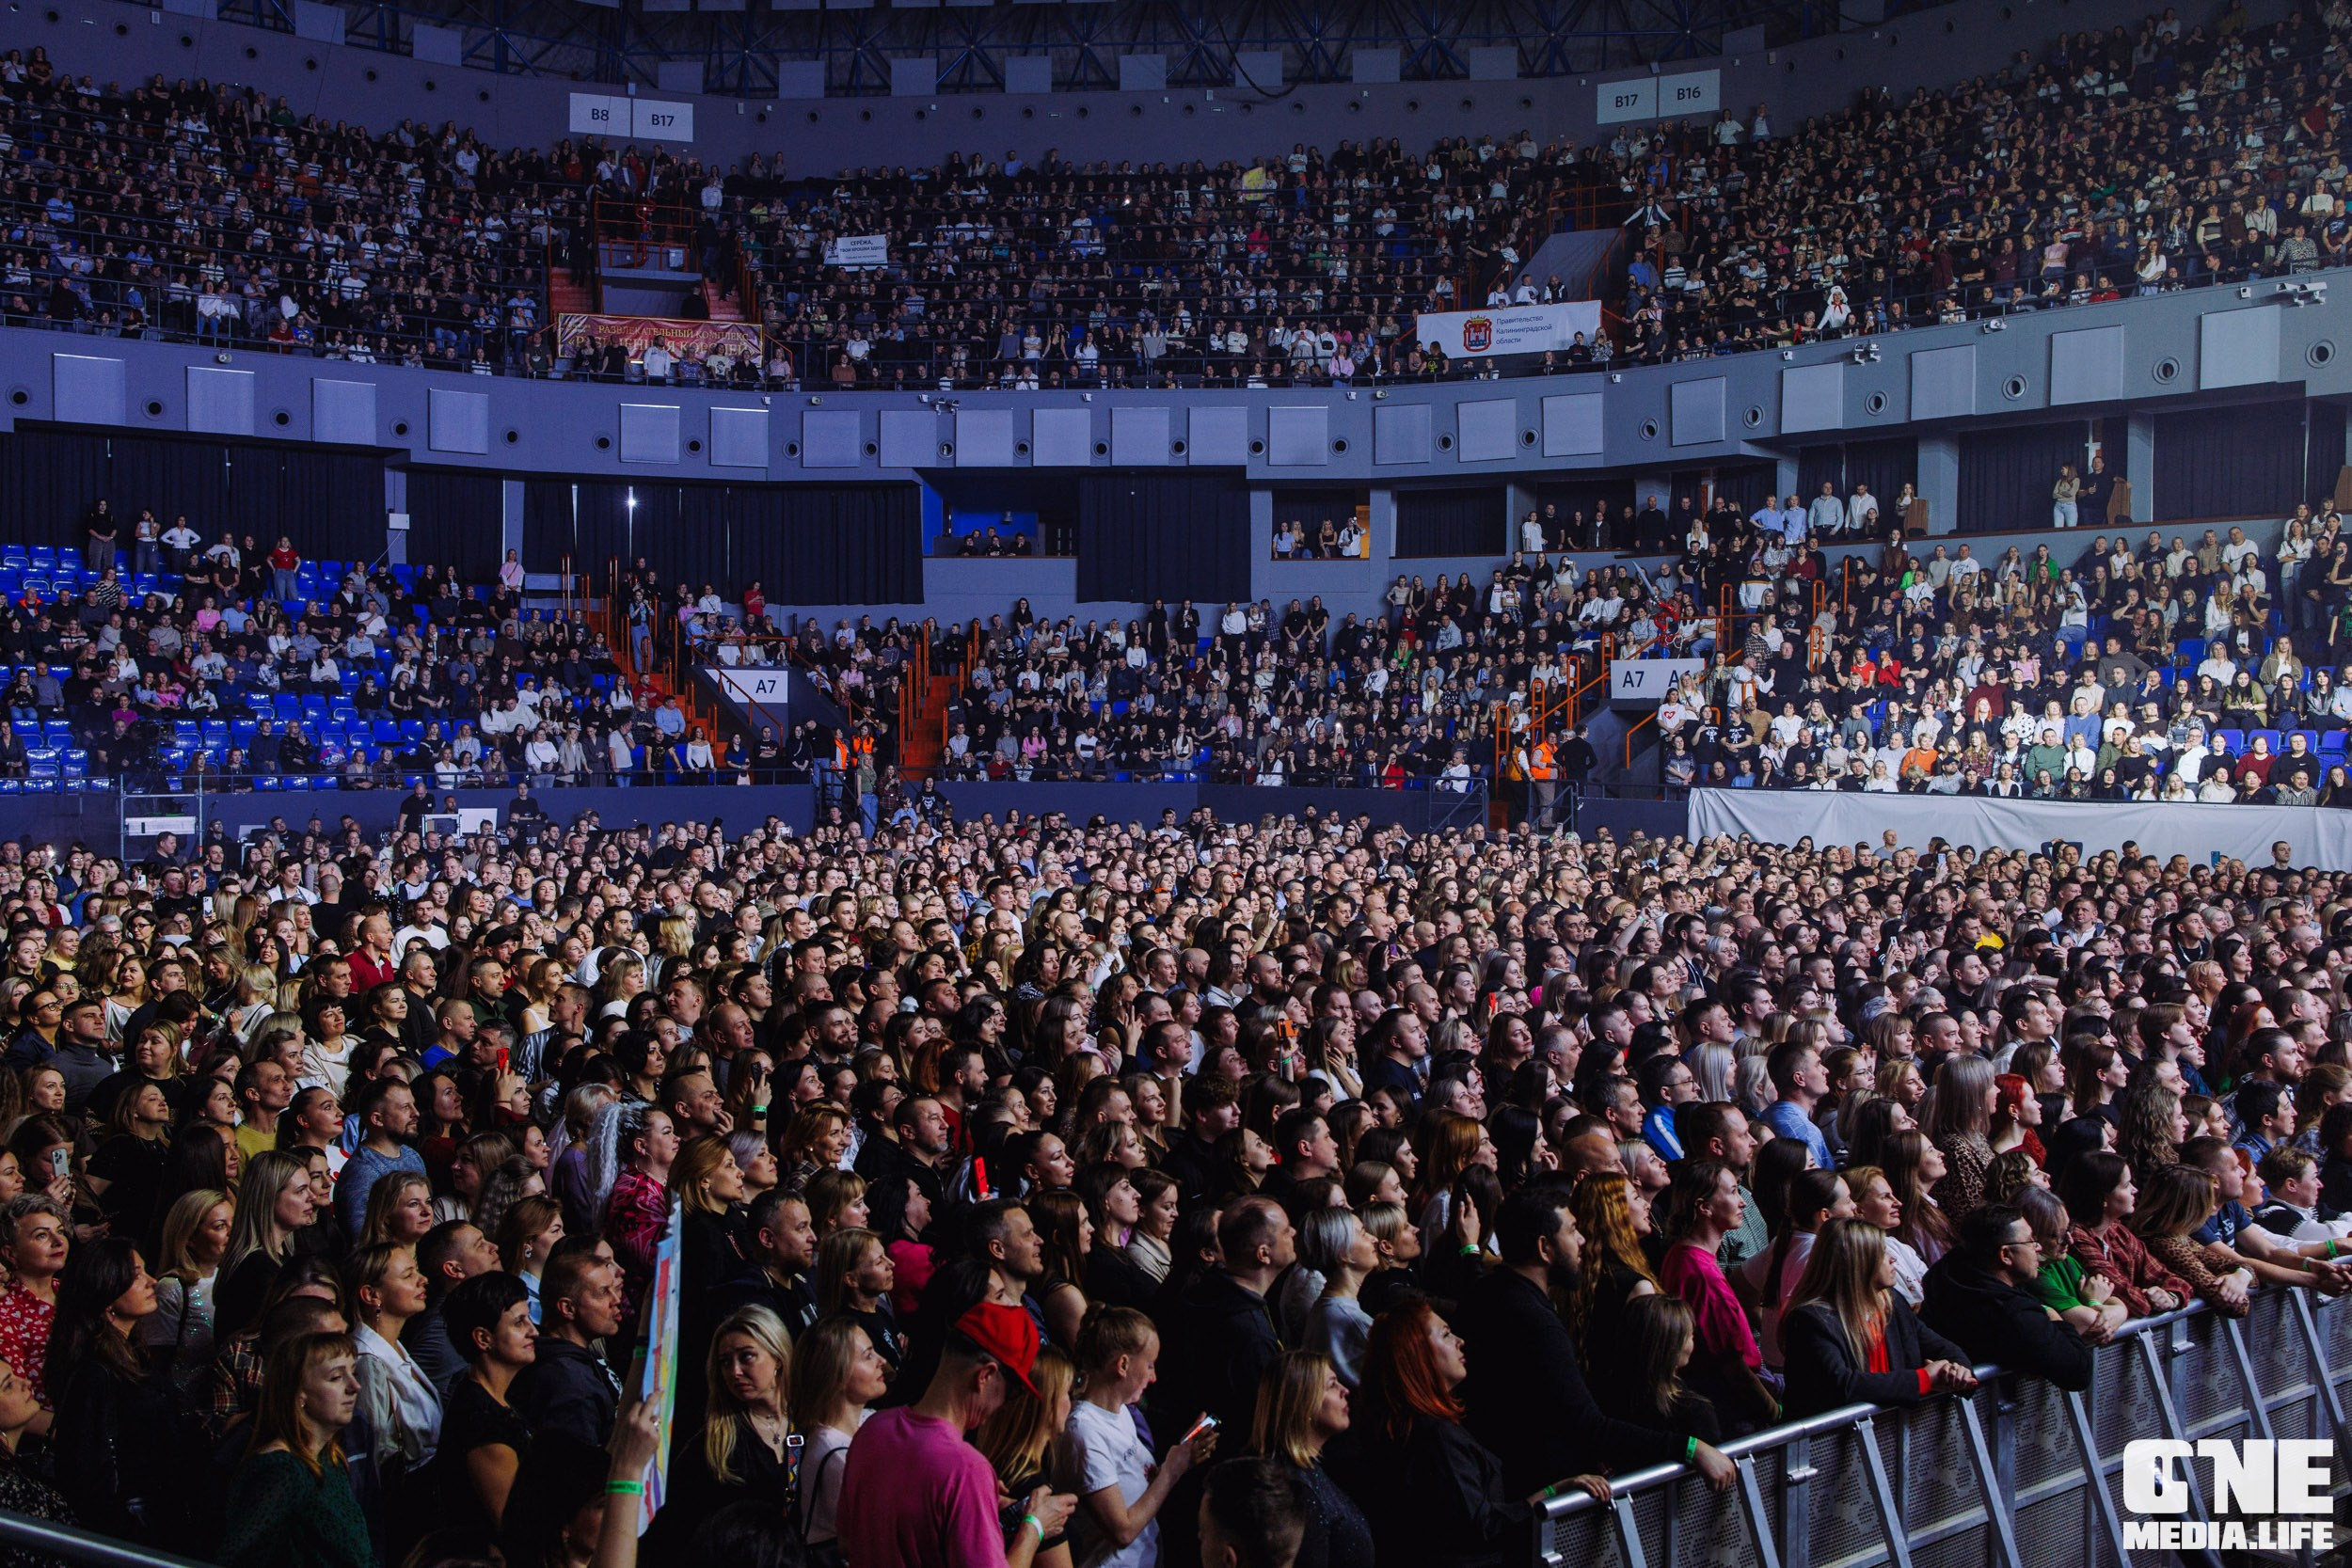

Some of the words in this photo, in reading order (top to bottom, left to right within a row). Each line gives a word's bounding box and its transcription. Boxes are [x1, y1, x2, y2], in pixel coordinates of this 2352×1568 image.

[1496, 315, 1544, 325] Правительство
[598, 325, 694, 339] РАЗВЛЕКАТЕЛЬНЫЙ
[695, 330, 749, 341] КОМПЛЕКС
[1496, 324, 1552, 336] Калининградской
[1495, 337, 1521, 345] области
